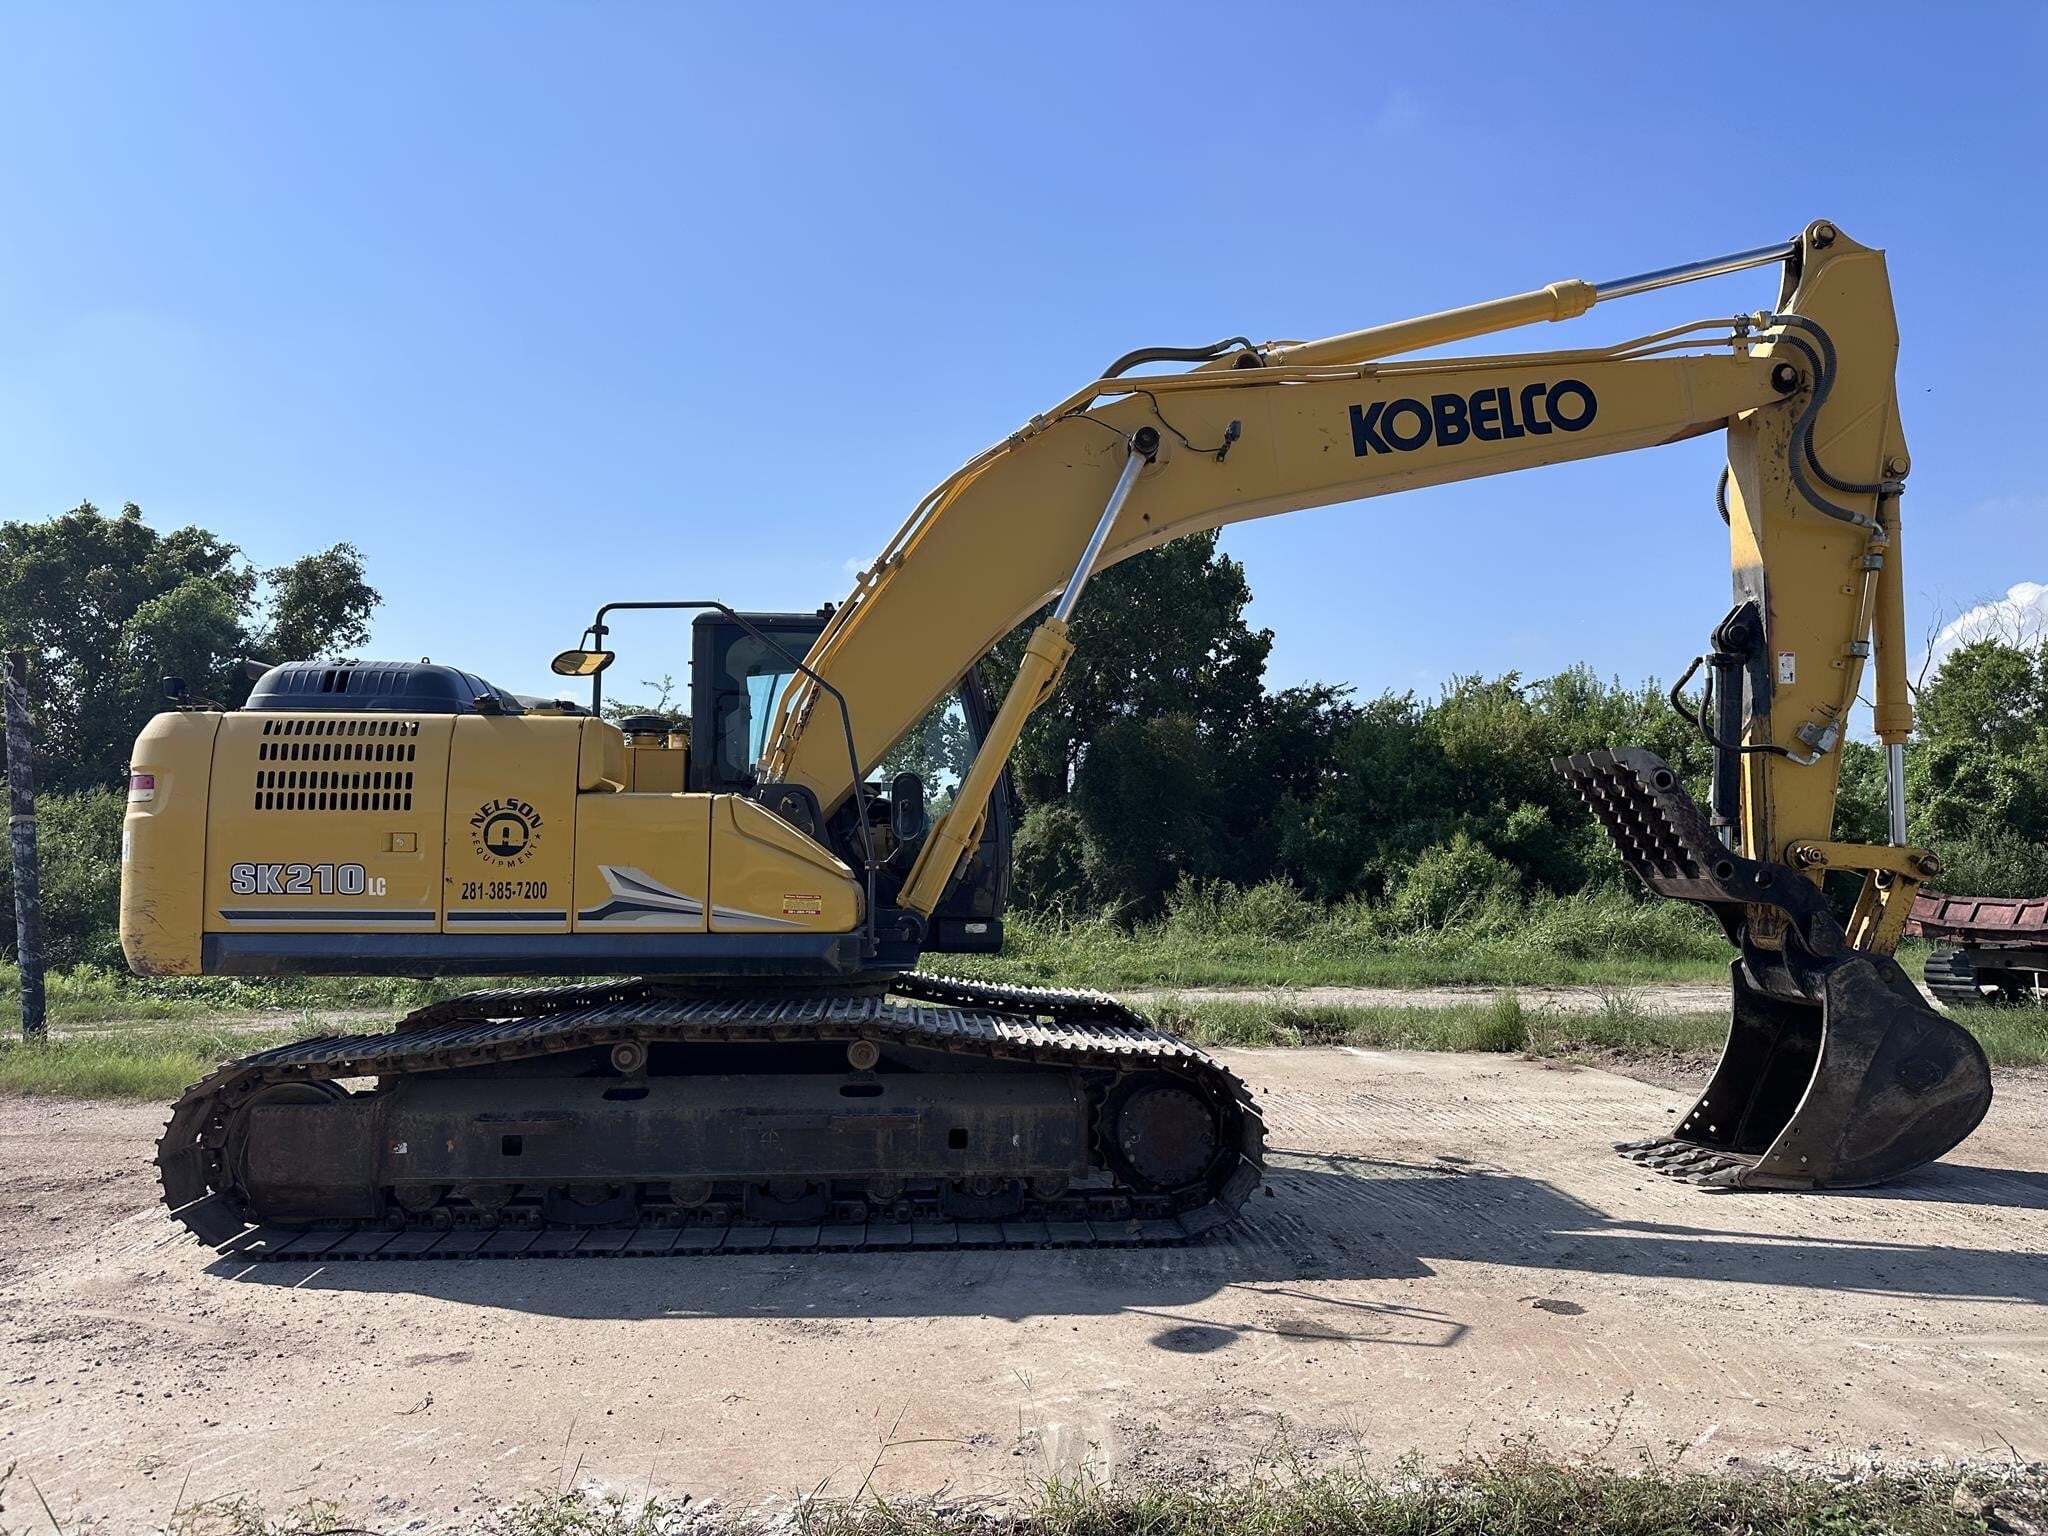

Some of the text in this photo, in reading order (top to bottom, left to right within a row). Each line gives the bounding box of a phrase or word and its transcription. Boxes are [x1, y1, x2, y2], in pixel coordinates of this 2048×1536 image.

[1349, 379, 1598, 457] KOBELCO
[469, 797, 544, 829] NELSON
[473, 838, 537, 869] EQUIPMENT
[230, 863, 387, 897] SK210 LC
[461, 881, 548, 900] 281-385-7200
